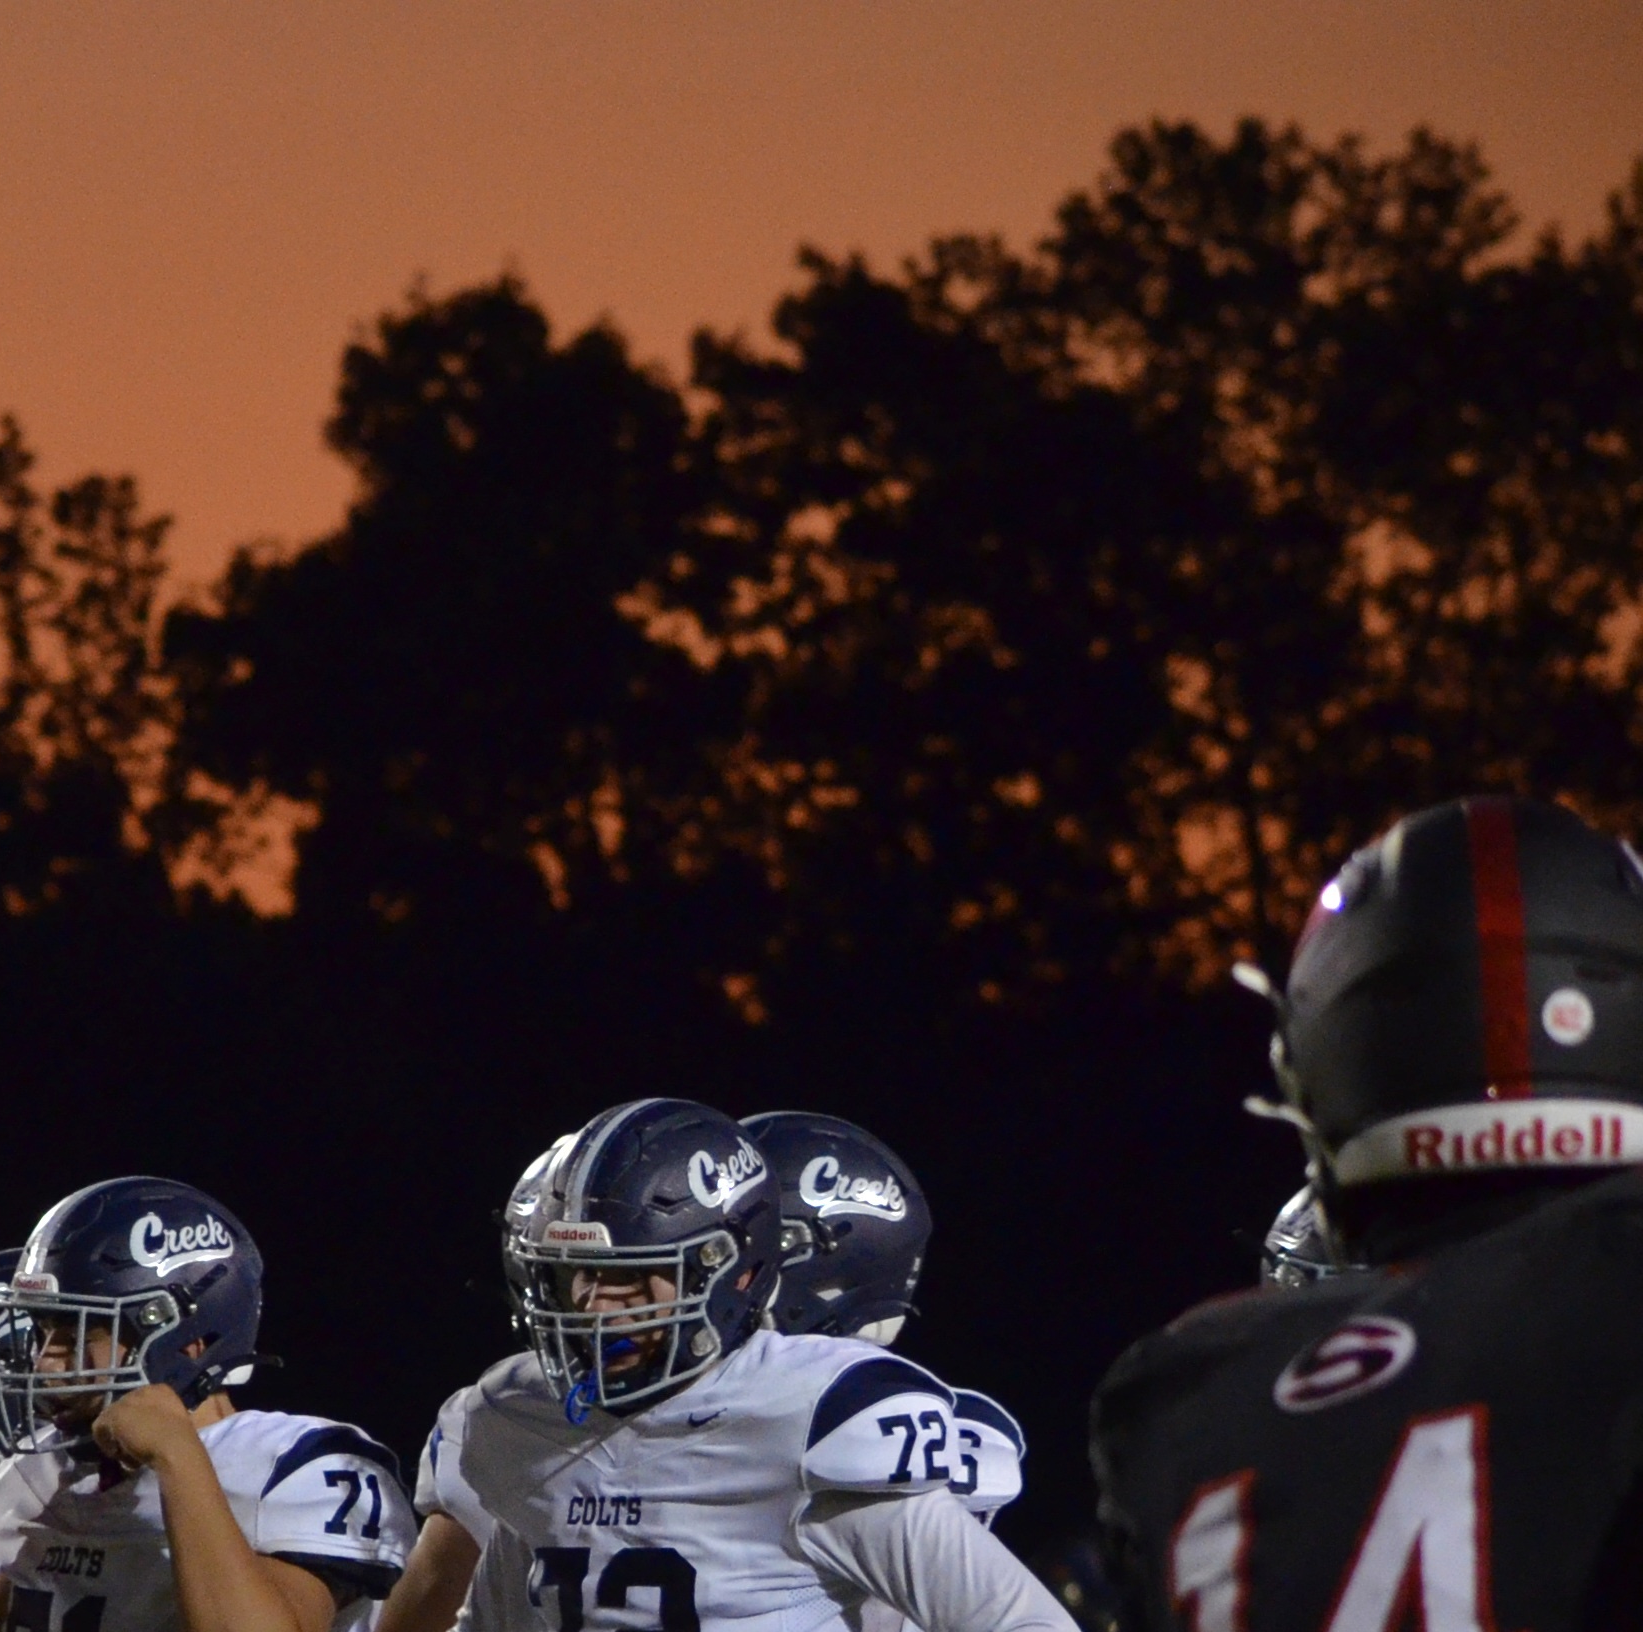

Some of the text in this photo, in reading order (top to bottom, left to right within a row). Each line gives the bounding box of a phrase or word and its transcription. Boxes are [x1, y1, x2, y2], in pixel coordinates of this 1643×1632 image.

[688, 1136, 767, 1213] Creek
[1403, 1114, 1622, 1172] Riddell
[799, 1156, 907, 1222] Creek
[130, 1212, 233, 1277] Creek
[877, 1410, 950, 1484] 72
[323, 1469, 382, 1540] 71
[567, 1496, 642, 1526] COLTS
